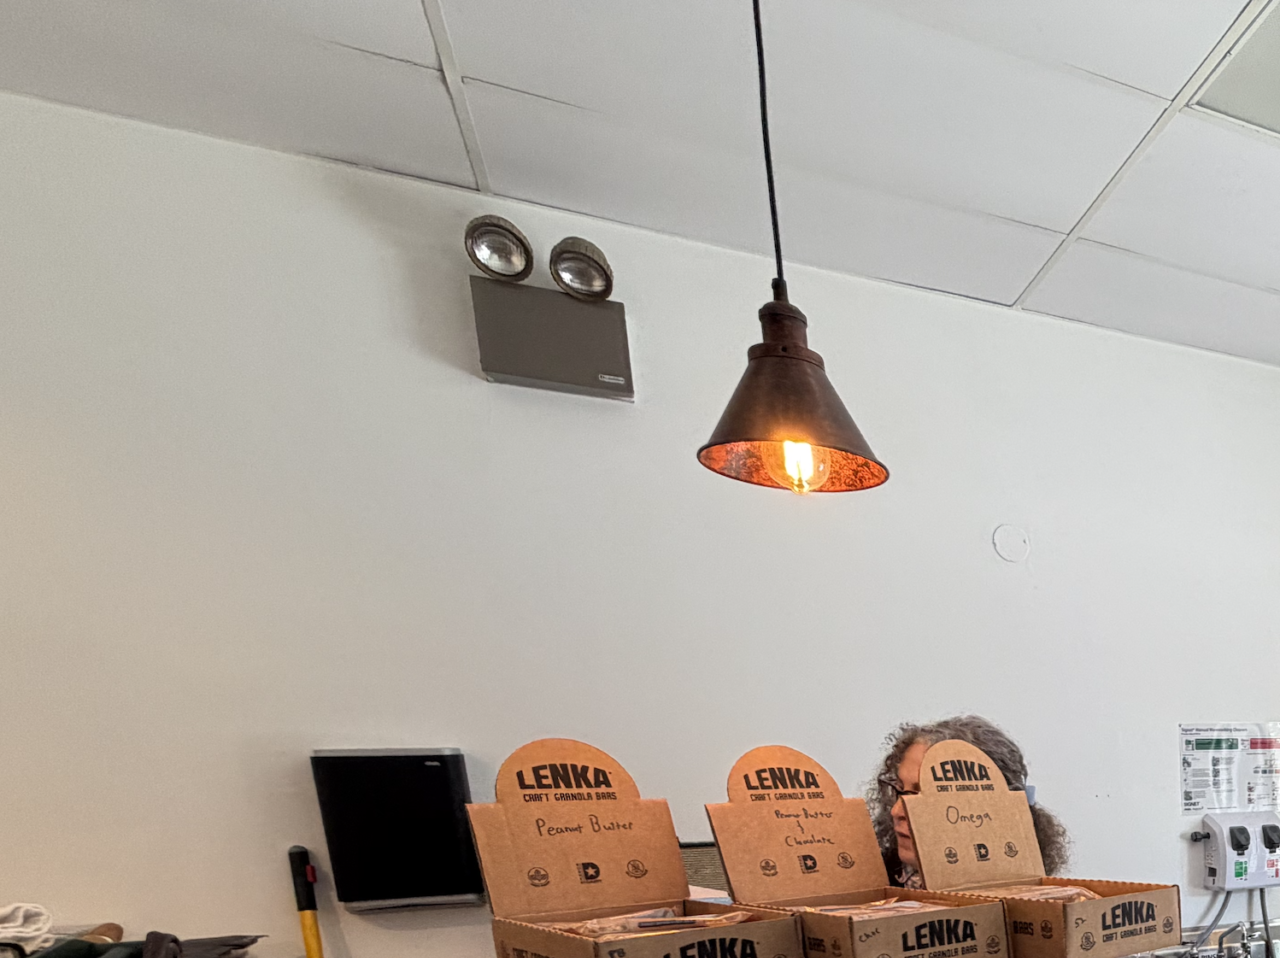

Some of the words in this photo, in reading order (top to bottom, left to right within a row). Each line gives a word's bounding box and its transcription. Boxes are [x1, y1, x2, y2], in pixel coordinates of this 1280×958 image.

[516, 763, 613, 790] LENKA
[743, 767, 820, 790] LENKA
[930, 759, 991, 782] LENKA
[523, 793, 549, 802] CRAFT
[554, 792, 593, 801] GRANOLA
[596, 791, 617, 800] BARS
[750, 793, 771, 801] CRAFT
[774, 792, 805, 800] GRANOLA
[936, 784, 953, 792] CRAFT
[955, 784, 980, 792] GRANOLA
[980, 783, 994, 791] BARS
[535, 817, 583, 836] Peanut
[588, 814, 633, 833] Butter
[946, 805, 992, 828] Omega
[785, 834, 835, 847] Chocolate
[1101, 900, 1157, 931] LENKA
[901, 918, 977, 952] LENKA
[1102, 932, 1118, 943] CRAFT
[1120, 928, 1143, 939] GRANOLA
[1144, 924, 1157, 935] BARS
[961, 944, 978, 955] BARS
